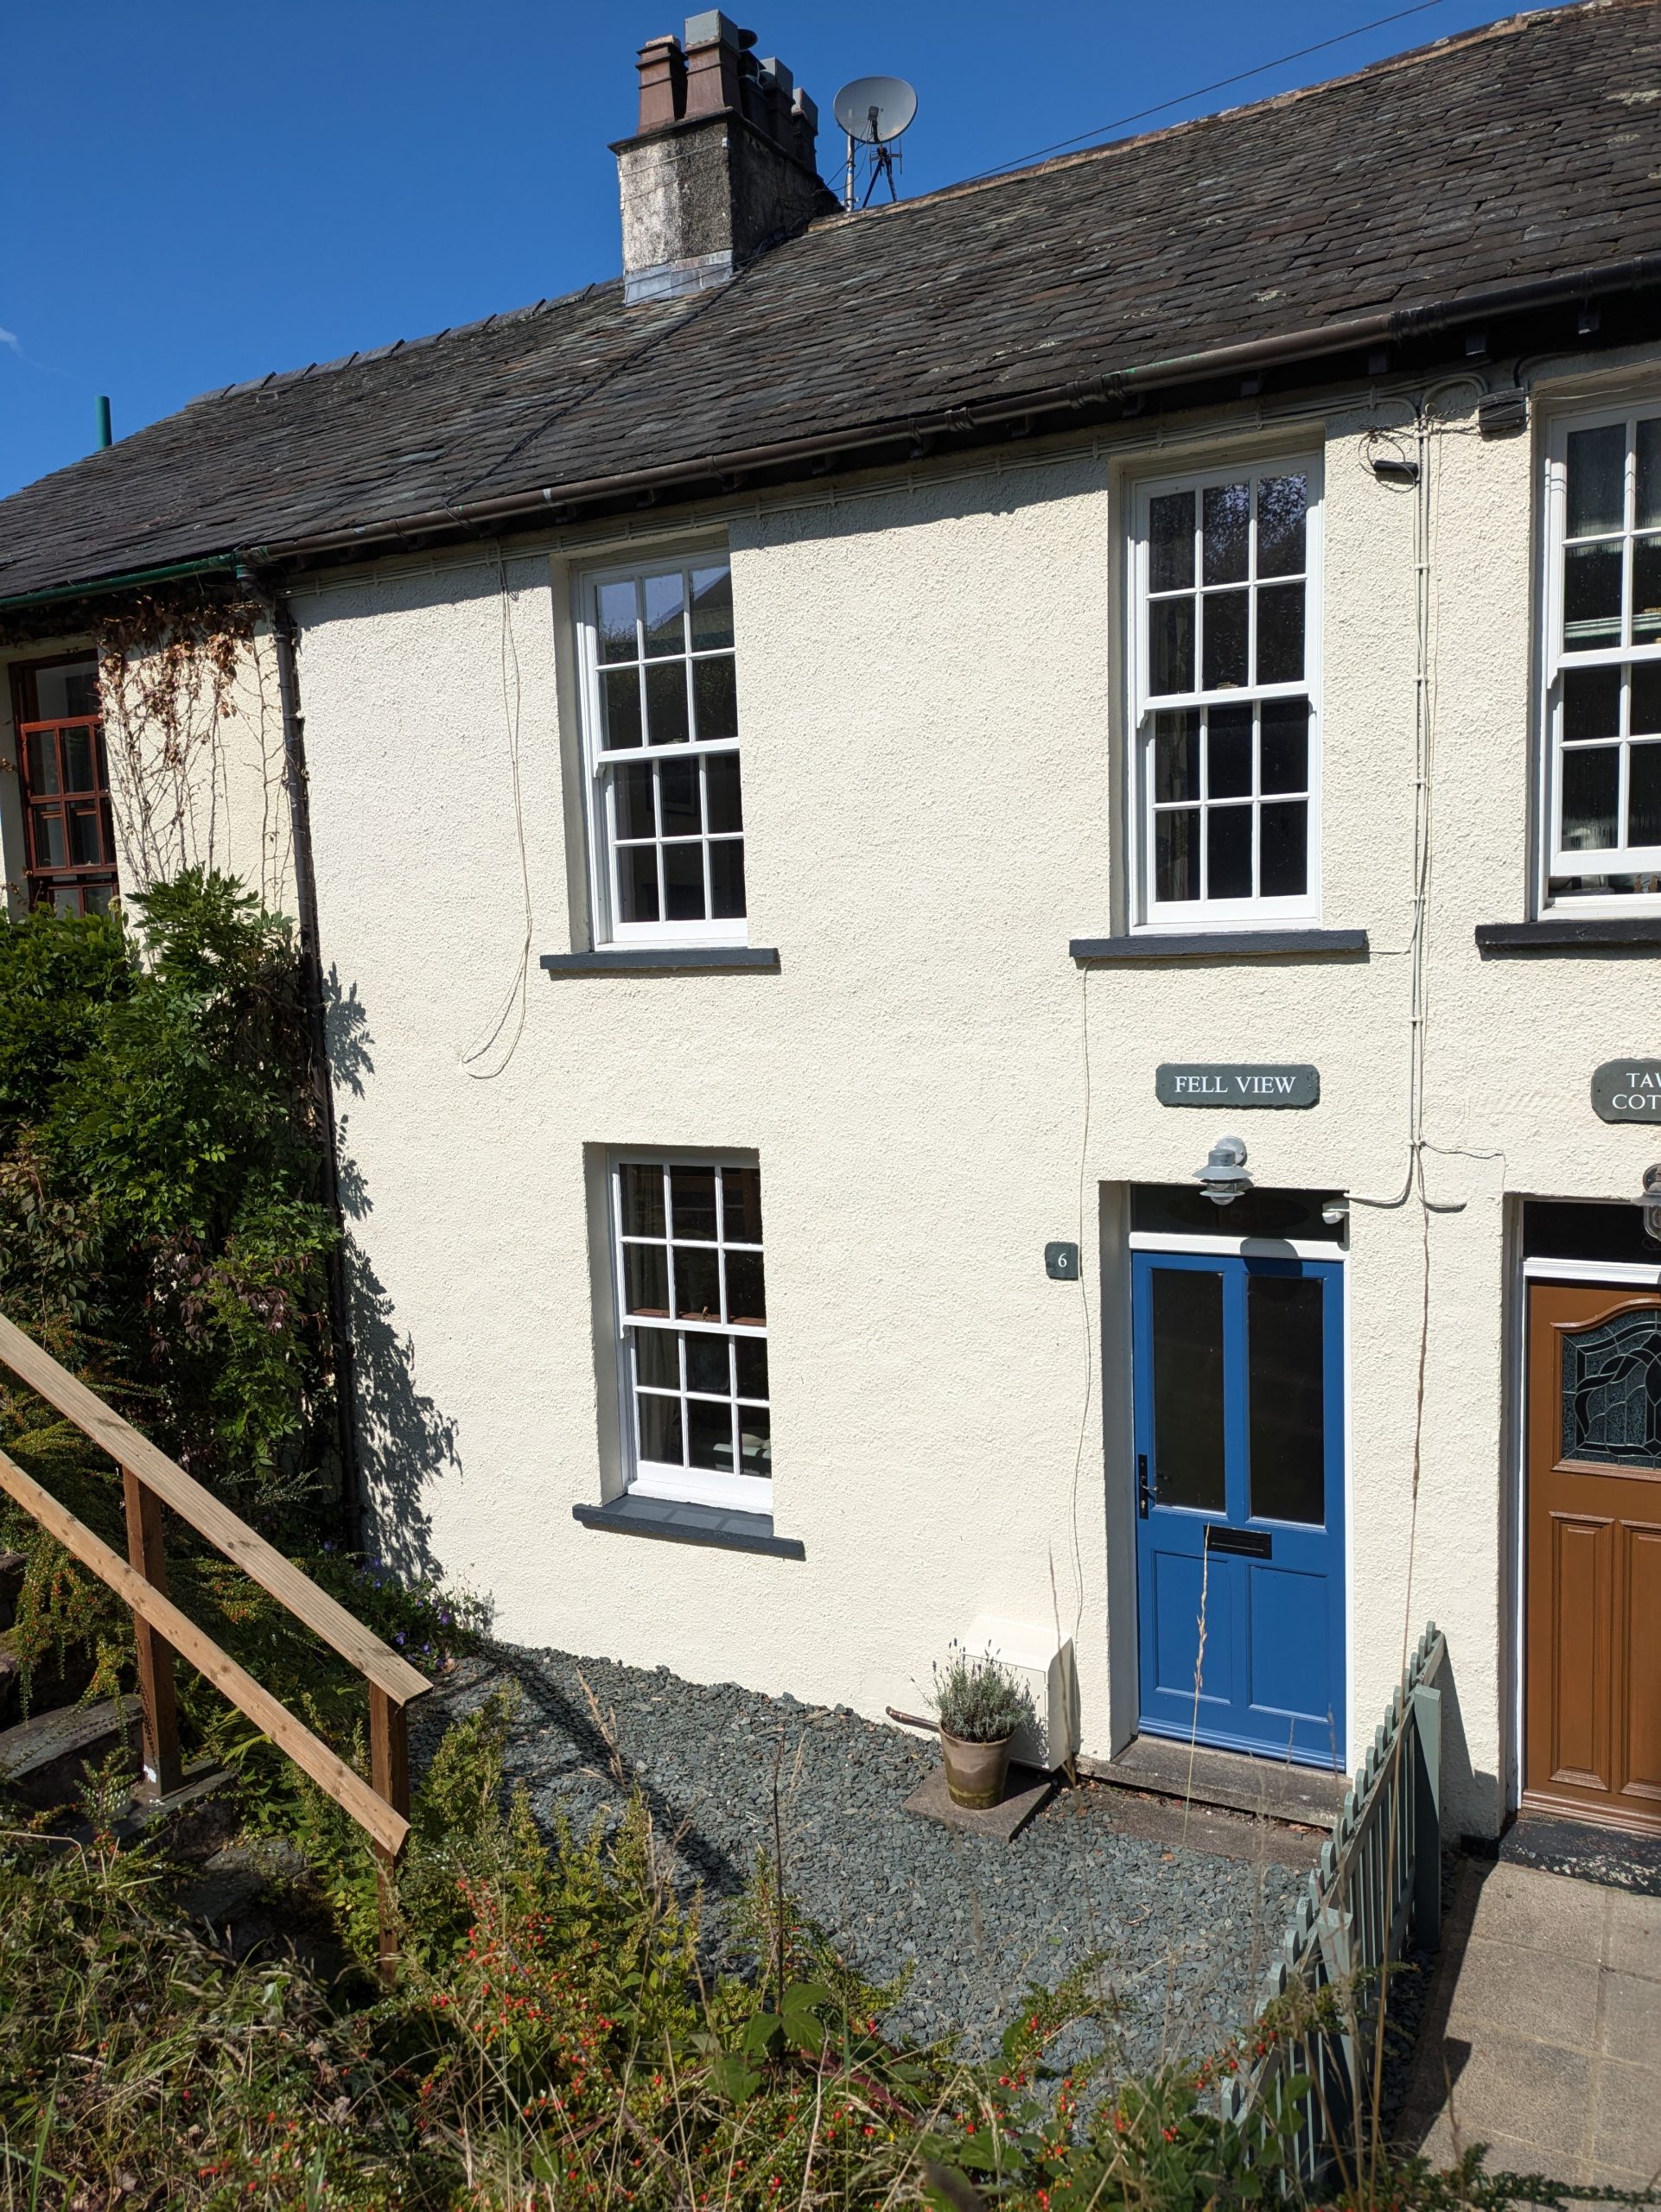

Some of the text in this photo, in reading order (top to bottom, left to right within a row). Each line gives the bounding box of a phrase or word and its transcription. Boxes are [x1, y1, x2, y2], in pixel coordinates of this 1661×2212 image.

[1174, 1076, 1296, 1094] FELL VIEW
[1058, 1253, 1067, 1268] 6
